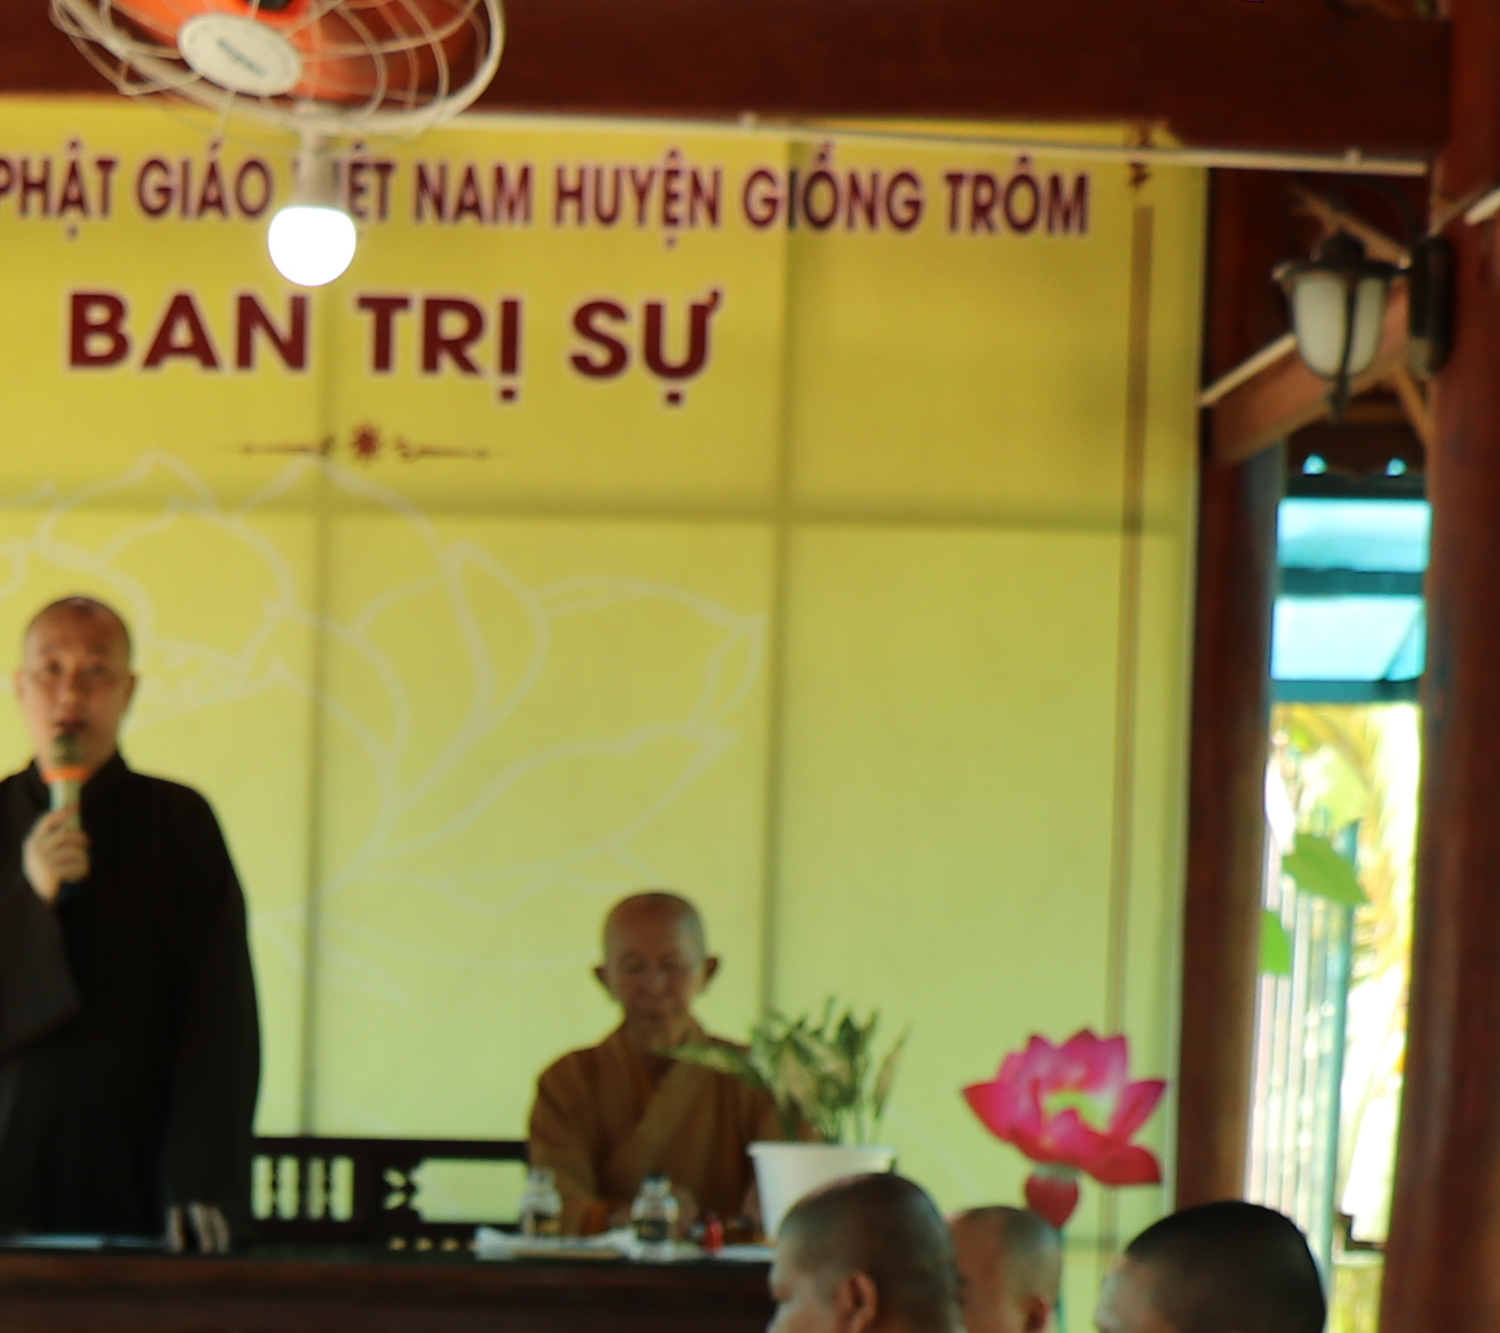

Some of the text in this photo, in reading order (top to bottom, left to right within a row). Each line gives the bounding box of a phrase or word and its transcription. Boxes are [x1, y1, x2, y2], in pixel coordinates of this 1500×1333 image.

[136, 139, 275, 220] GIÁO
[413, 162, 532, 227] NAM
[554, 148, 722, 249] HUYỆN
[946, 153, 1090, 239] TRÔM
[68, 290, 722, 406] BAN TRỊ SỰ
